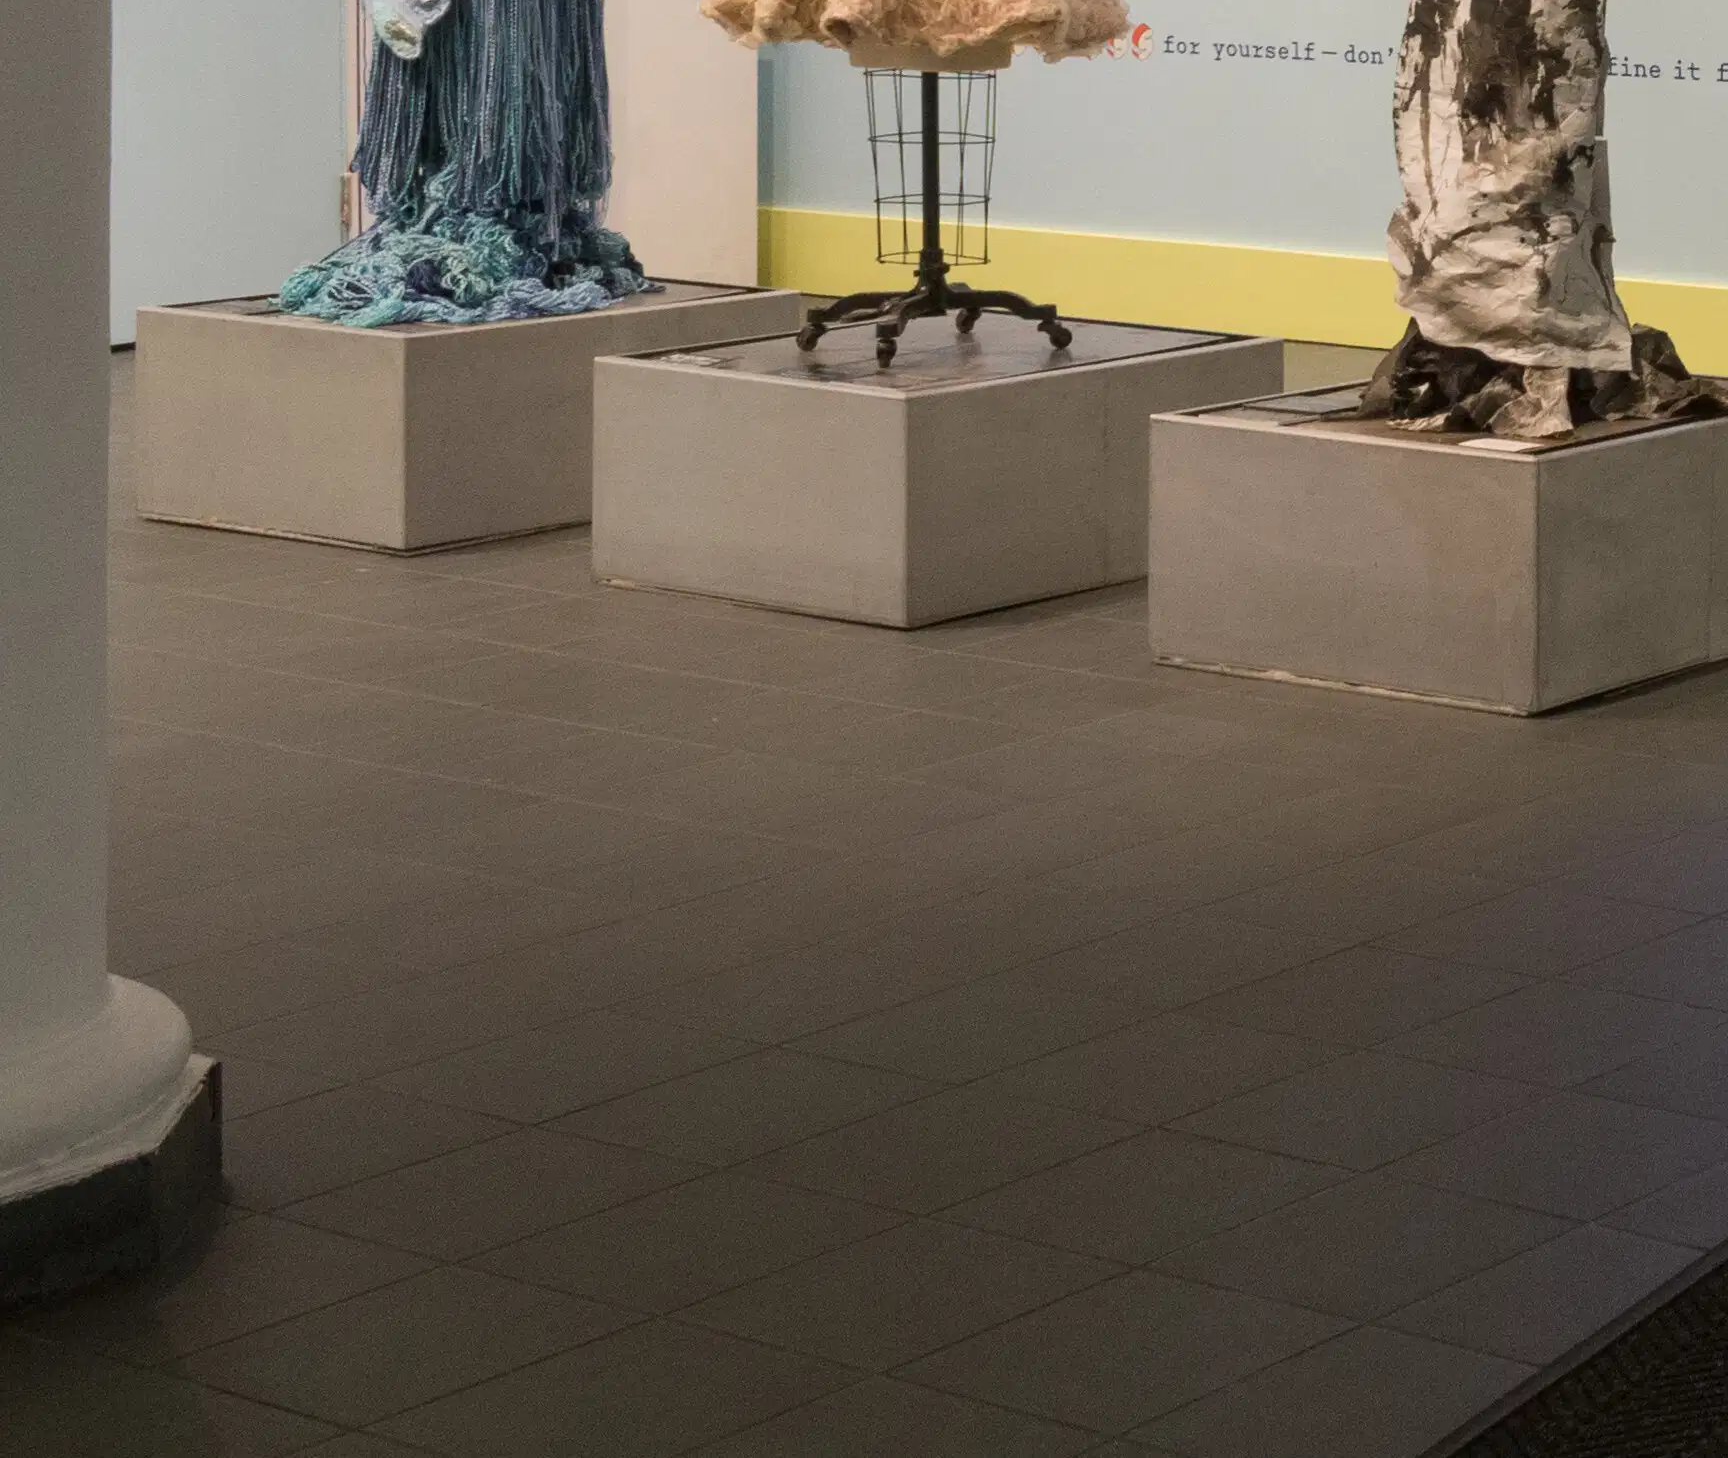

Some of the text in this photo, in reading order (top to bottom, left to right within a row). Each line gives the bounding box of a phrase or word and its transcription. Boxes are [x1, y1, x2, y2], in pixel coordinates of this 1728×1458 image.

[1164, 35, 1201, 55] for
[1608, 57, 1661, 78] fine
[1674, 59, 1700, 80] it
